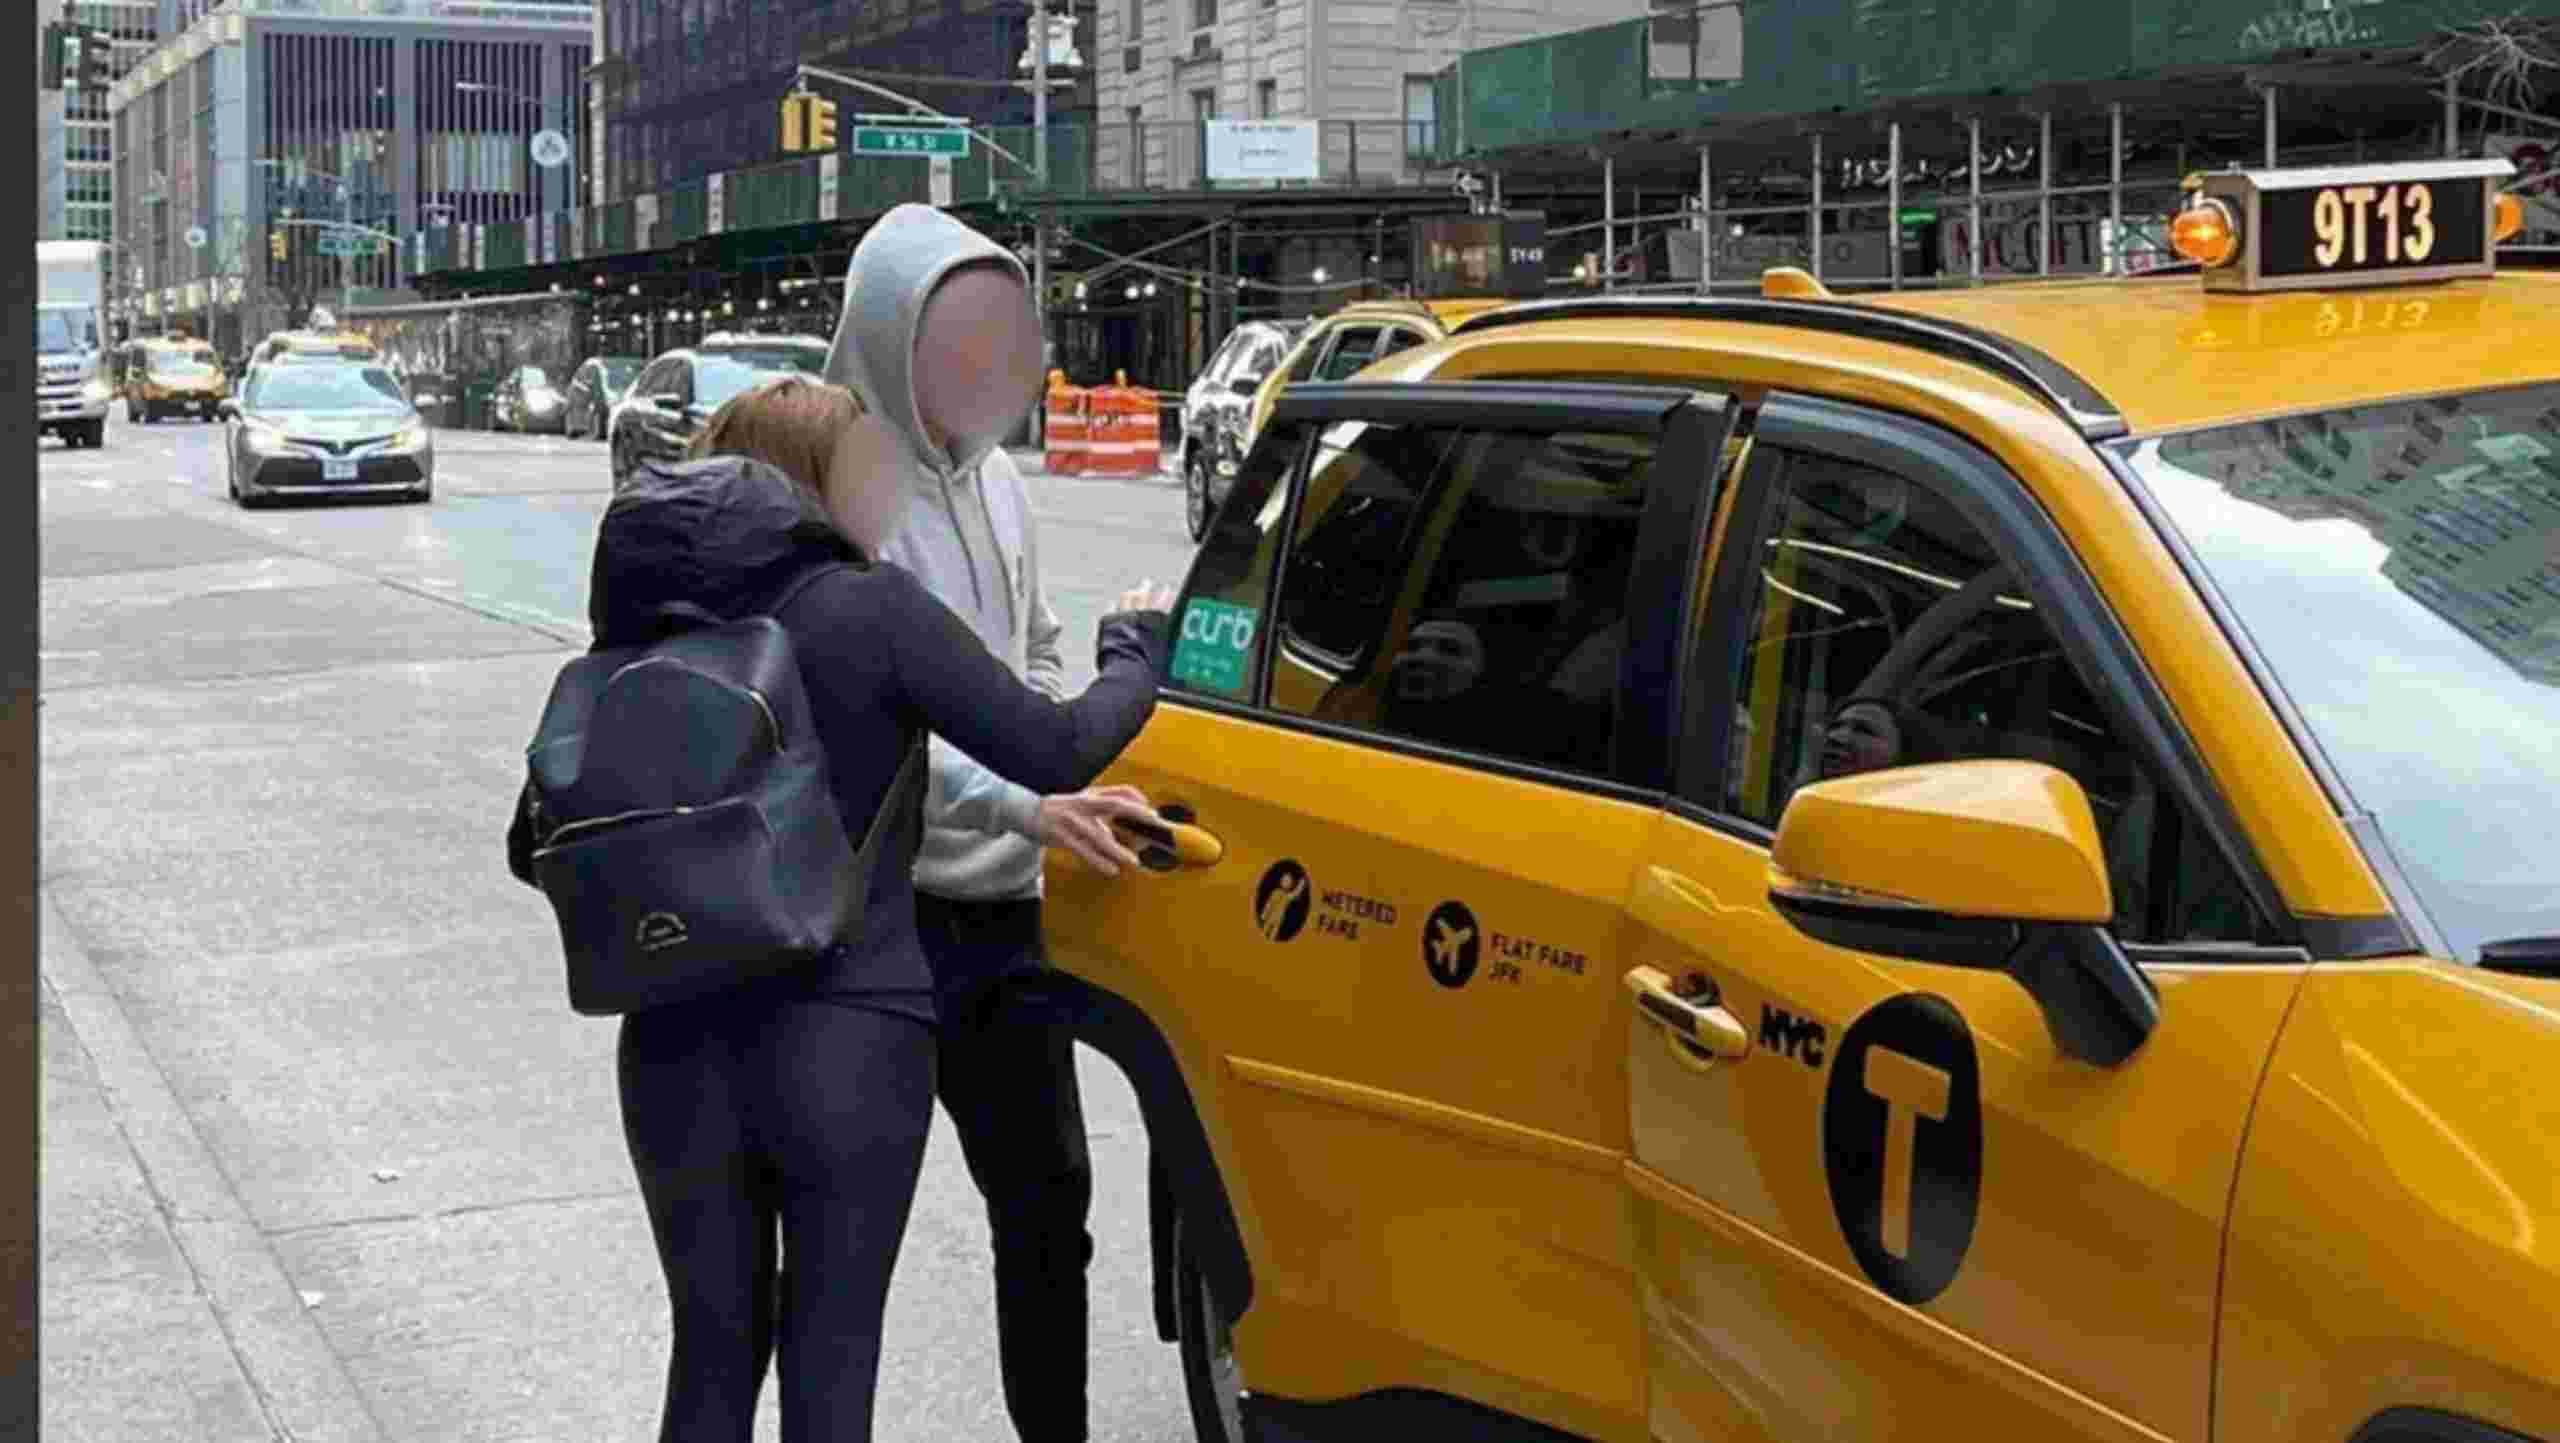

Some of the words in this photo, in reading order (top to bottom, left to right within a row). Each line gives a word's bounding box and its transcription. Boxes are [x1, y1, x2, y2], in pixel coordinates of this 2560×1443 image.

[2314, 183, 2435, 266] 9T13
[1183, 607, 1254, 651] curb
[1319, 912, 1358, 942] FARE
[1322, 892, 1397, 928] METERED
[1489, 959, 1522, 984] JFK
[1491, 930, 1535, 959] FLAT
[1538, 944, 1587, 977] FARE
[1759, 1001, 1827, 1068] NYC
[1863, 1043, 1951, 1259] T
